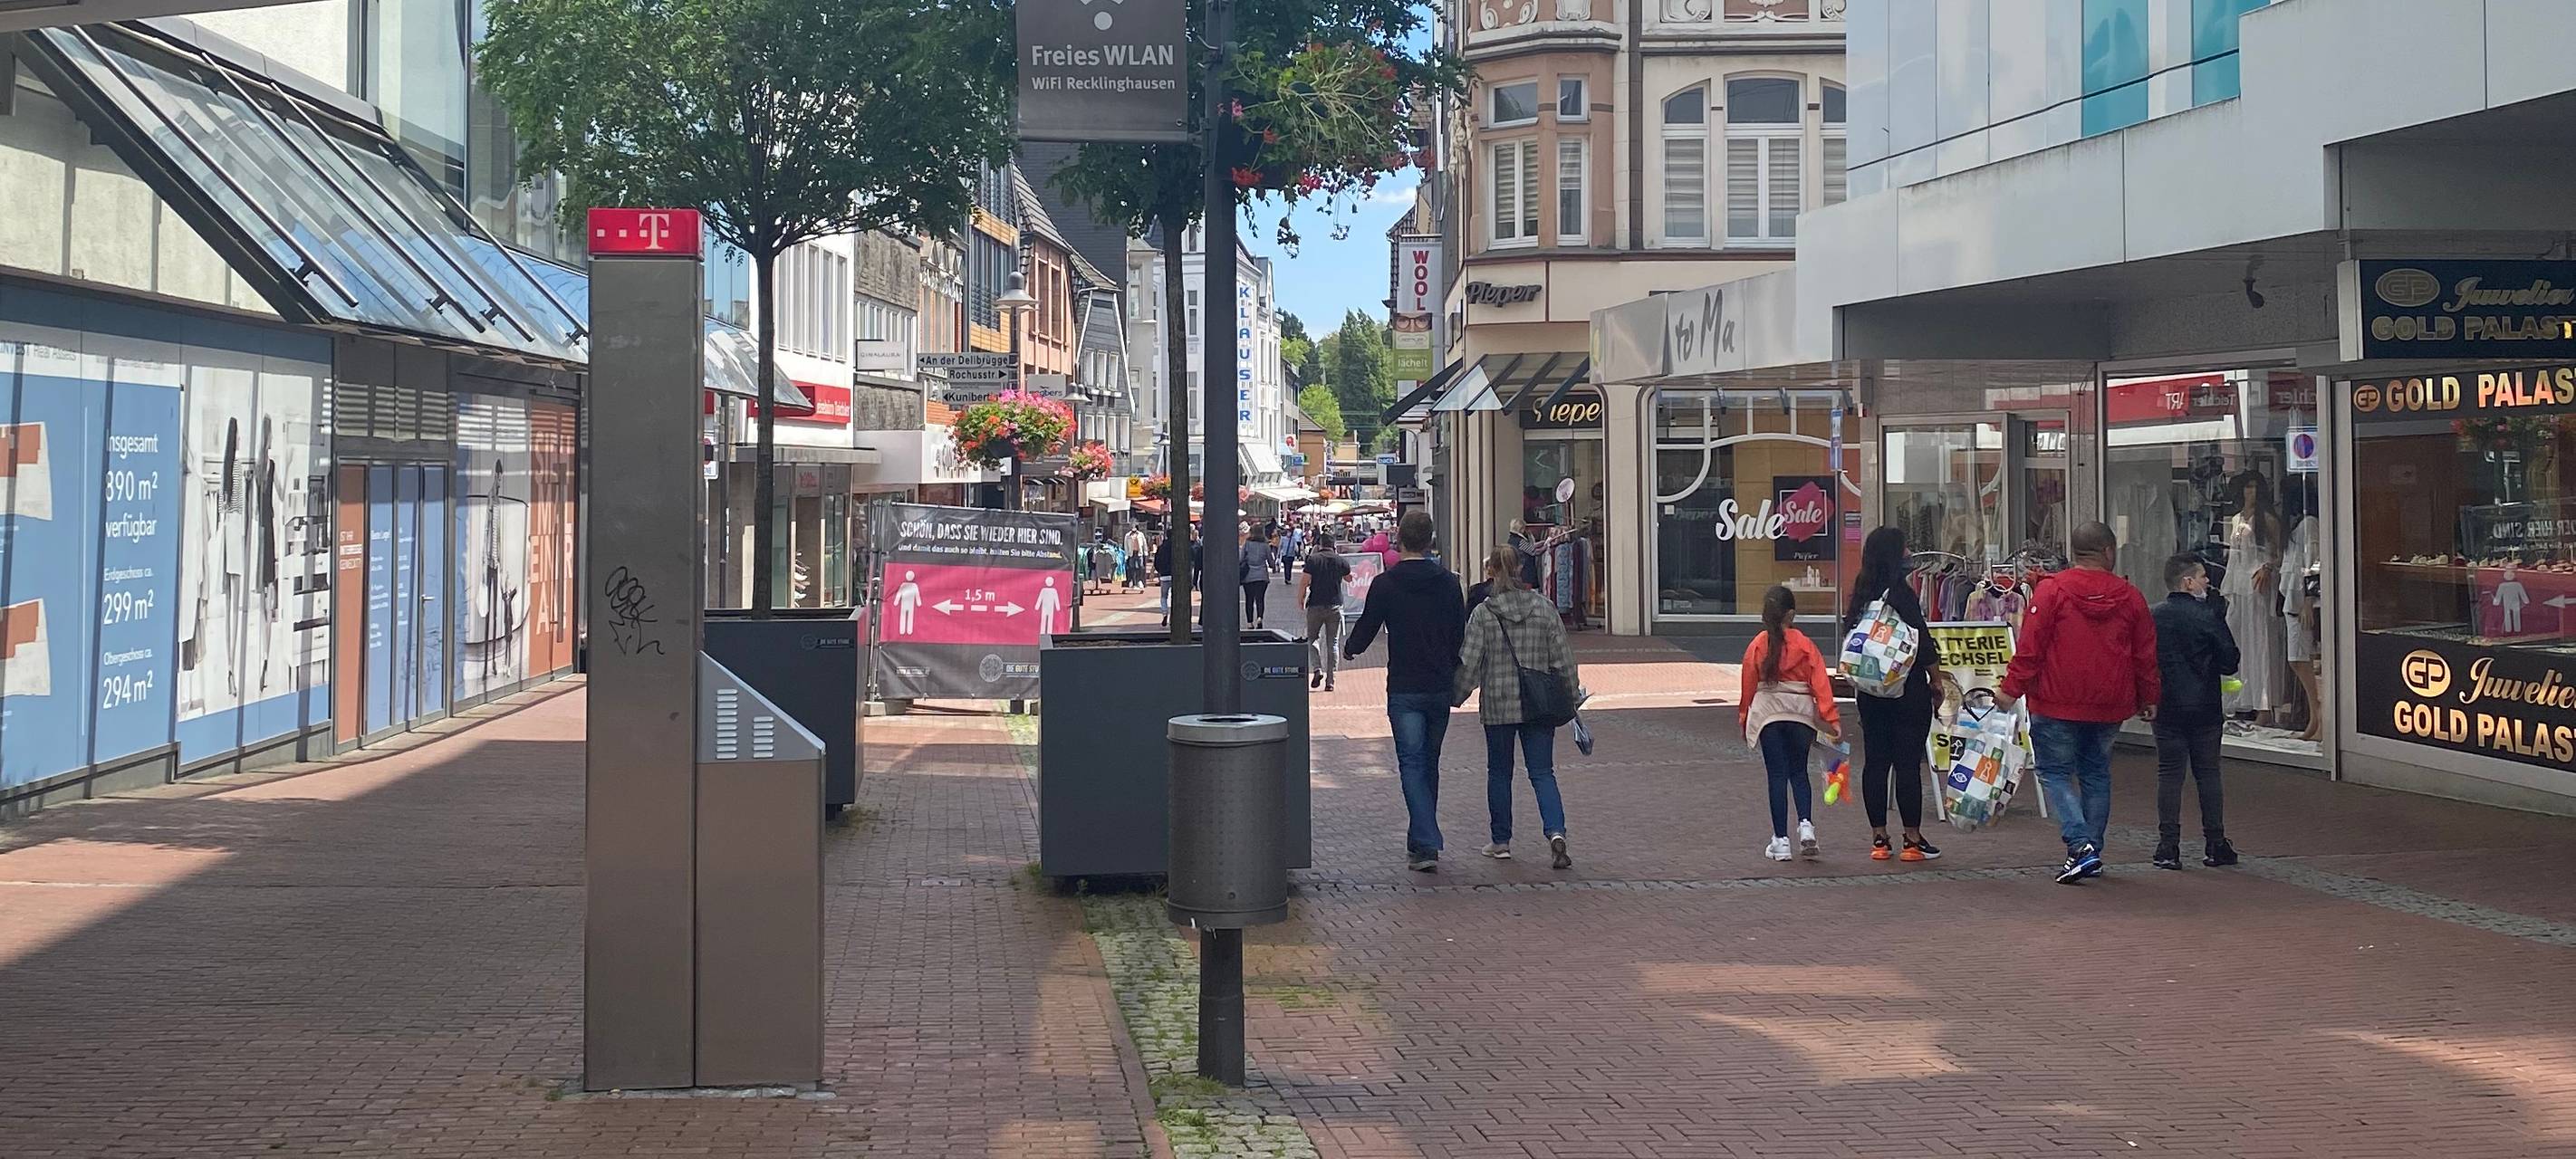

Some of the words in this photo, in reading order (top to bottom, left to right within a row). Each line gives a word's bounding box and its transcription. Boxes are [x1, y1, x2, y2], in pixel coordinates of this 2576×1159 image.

[1032, 44, 1101, 66] Freies
[1103, 45, 1174, 65] WLAN
[1067, 76, 1176, 92] Recklinghausen
[1465, 282, 1543, 308] Pieper
[2371, 316, 2456, 340] GOLD
[926, 356, 937, 365] An
[940, 356, 956, 365] der
[958, 355, 1008, 366] Dellbrügge
[1239, 287, 1251, 421] KLAUSER
[2386, 376, 2461, 412] GOLD
[2478, 367, 2576, 408] PALAS
[1715, 498, 1787, 541] Sale
[1784, 501, 1823, 523] Sale
[105, 512, 157, 543] verfügbar
[899, 519, 935, 541] SCHÖN,
[937, 523, 961, 540] DASS
[964, 524, 977, 541] SIE
[981, 525, 1014, 542] WIEDER
[1017, 527, 1037, 543] HIER
[1039, 529, 1063, 545] SIND.
[1010, 549, 1021, 557] Sie
[103, 590, 131, 625] 299
[965, 589, 982, 602] 1,5
[985, 591, 995, 601] m
[103, 674, 131, 709] 294
[2459, 657, 2576, 709] Juwelie
[2394, 700, 2468, 743] GOLD
[2477, 713, 2576, 762] PALAS
